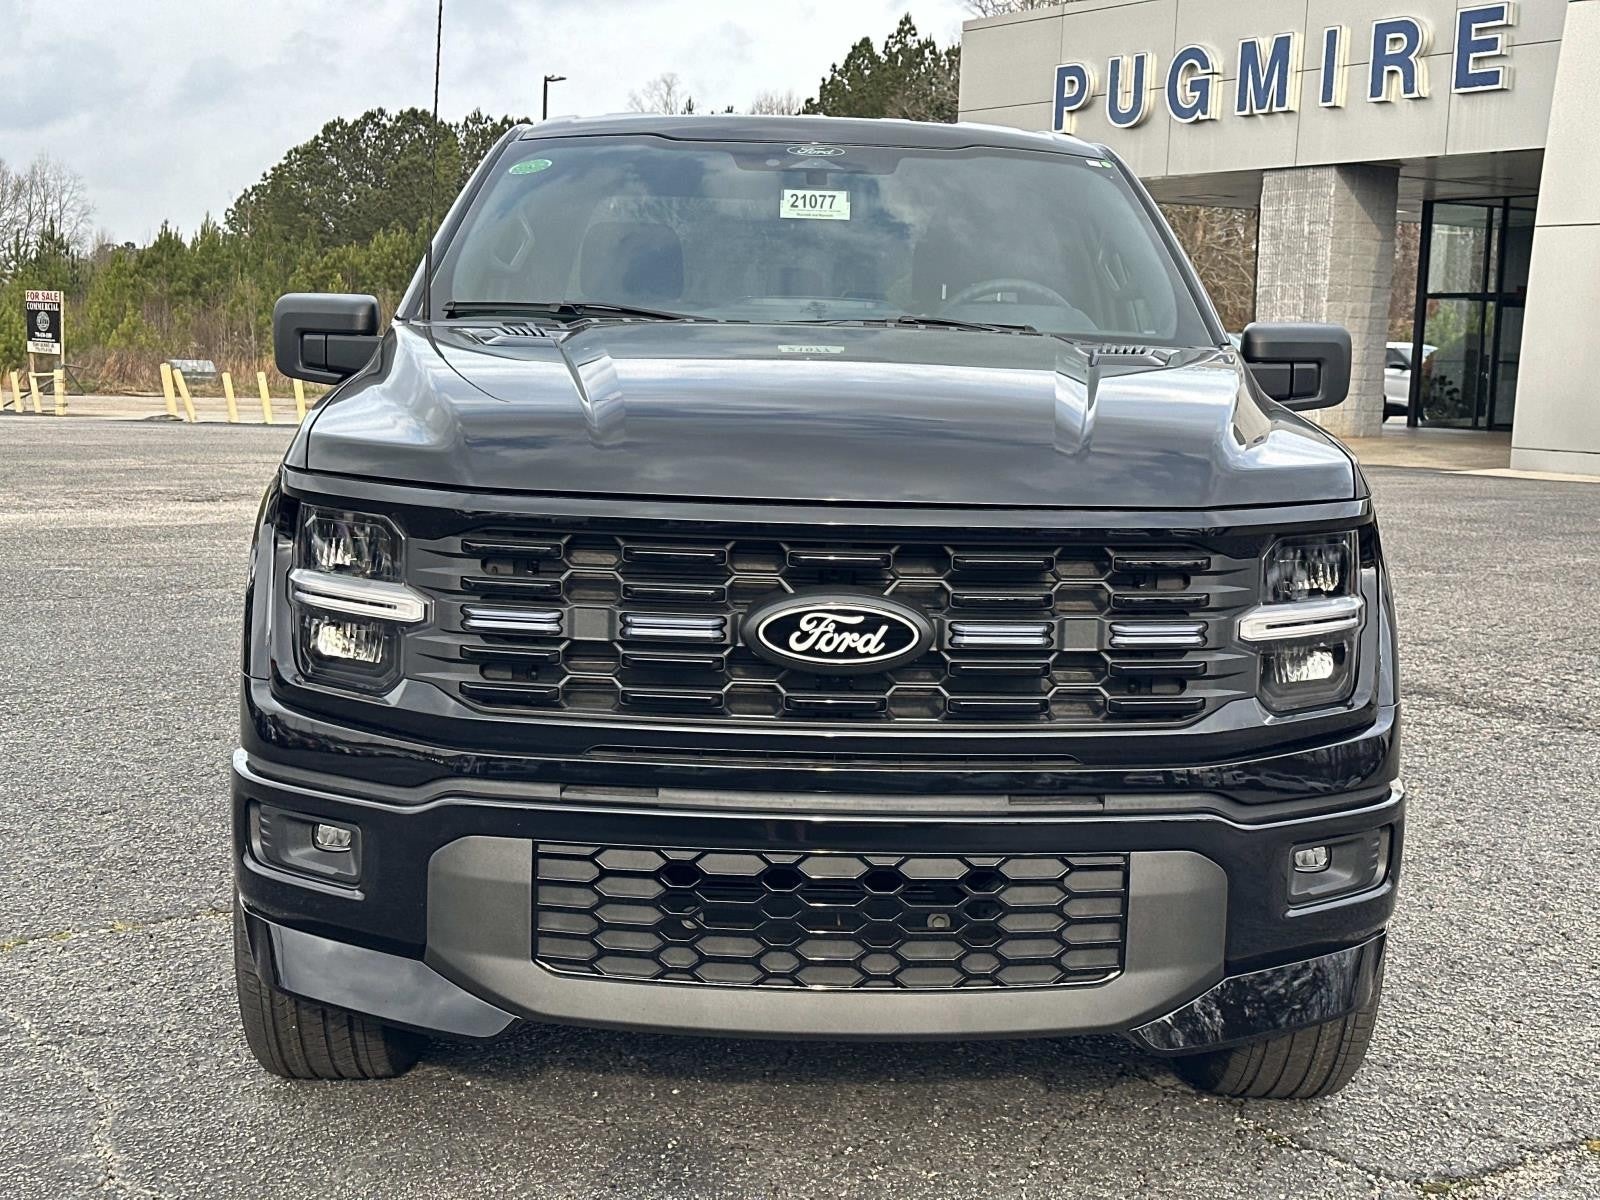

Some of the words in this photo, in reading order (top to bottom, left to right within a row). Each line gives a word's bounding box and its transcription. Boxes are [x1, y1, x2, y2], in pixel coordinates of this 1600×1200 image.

[1052, 3, 1514, 133] PUGMIRE
[797, 146, 834, 155] Ford
[790, 193, 836, 209] 21077
[27, 291, 40, 300] FOR
[41, 292, 58, 301] SALE
[27, 302, 59, 311] COMMERCIAL
[788, 612, 889, 654] Ford
